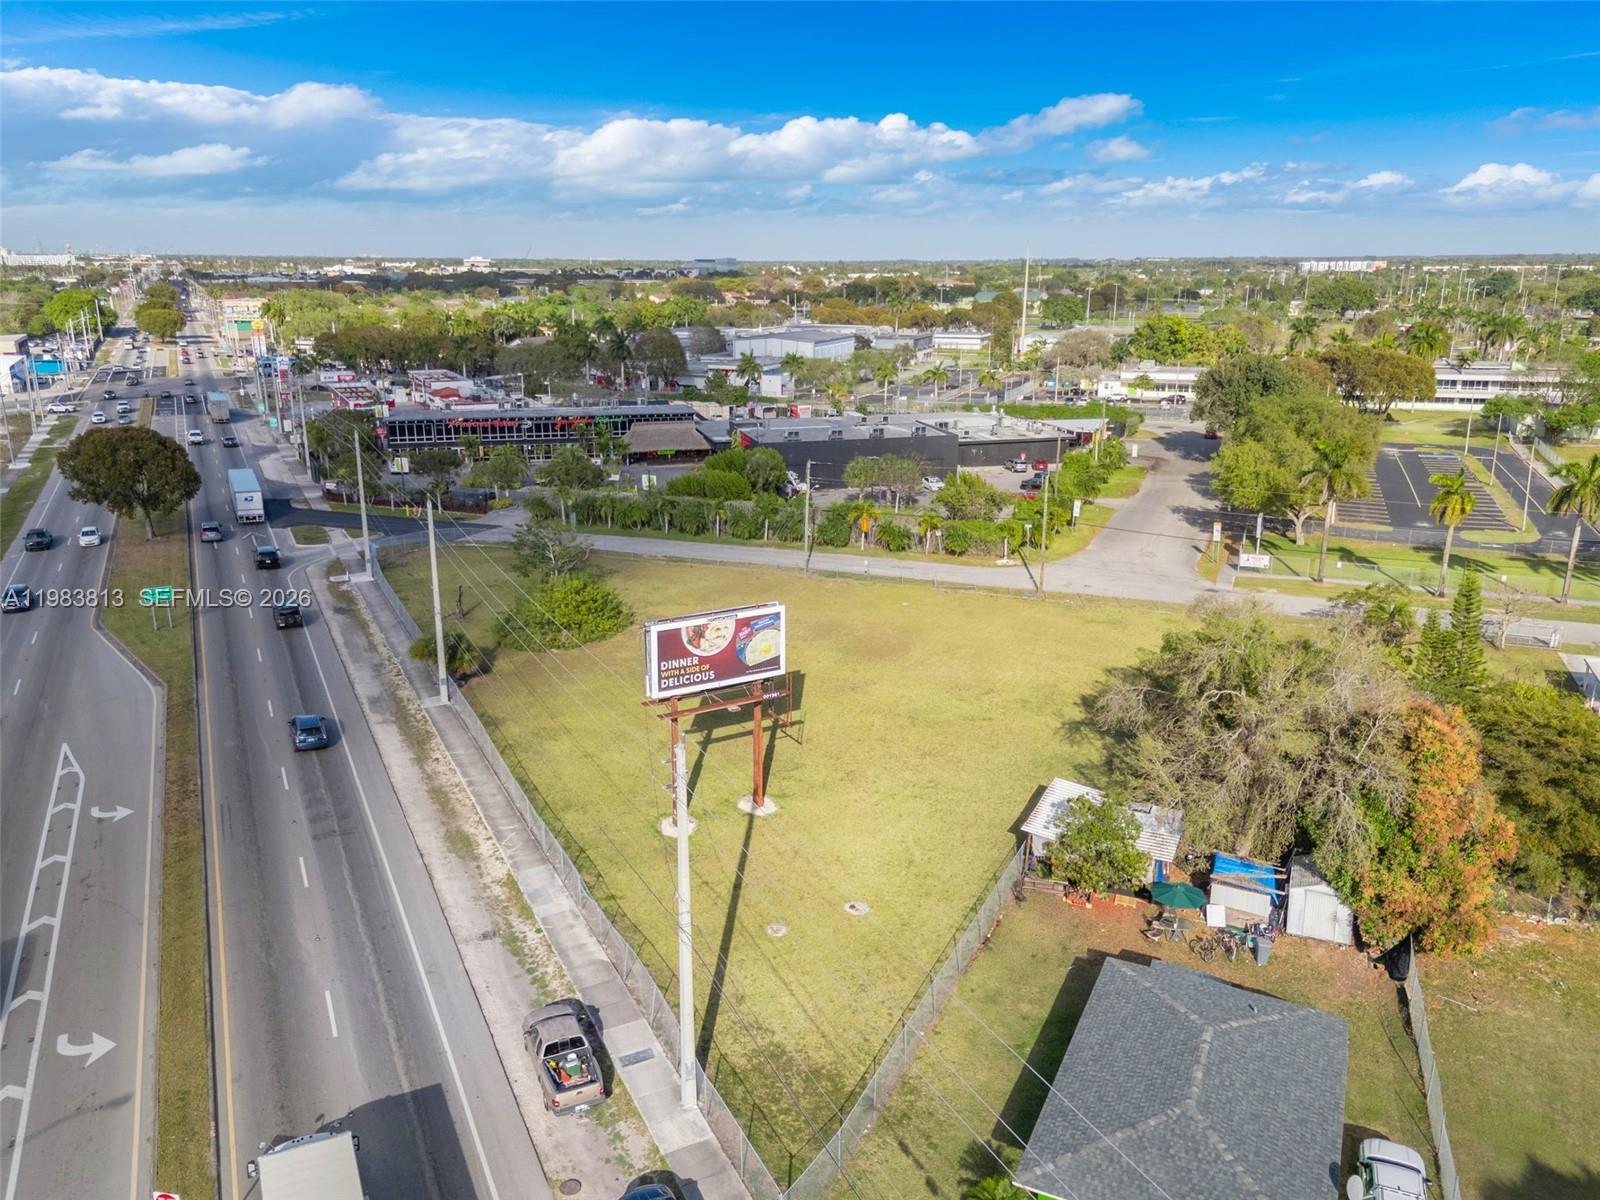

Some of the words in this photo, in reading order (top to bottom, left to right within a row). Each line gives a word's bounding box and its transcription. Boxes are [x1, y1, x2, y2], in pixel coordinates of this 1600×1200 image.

[661, 656, 699, 671] DINNER
[661, 668, 679, 678] WITH
[686, 665, 700, 674] SIDE
[701, 663, 711, 671] OF
[661, 670, 715, 689] DELICIOUS
